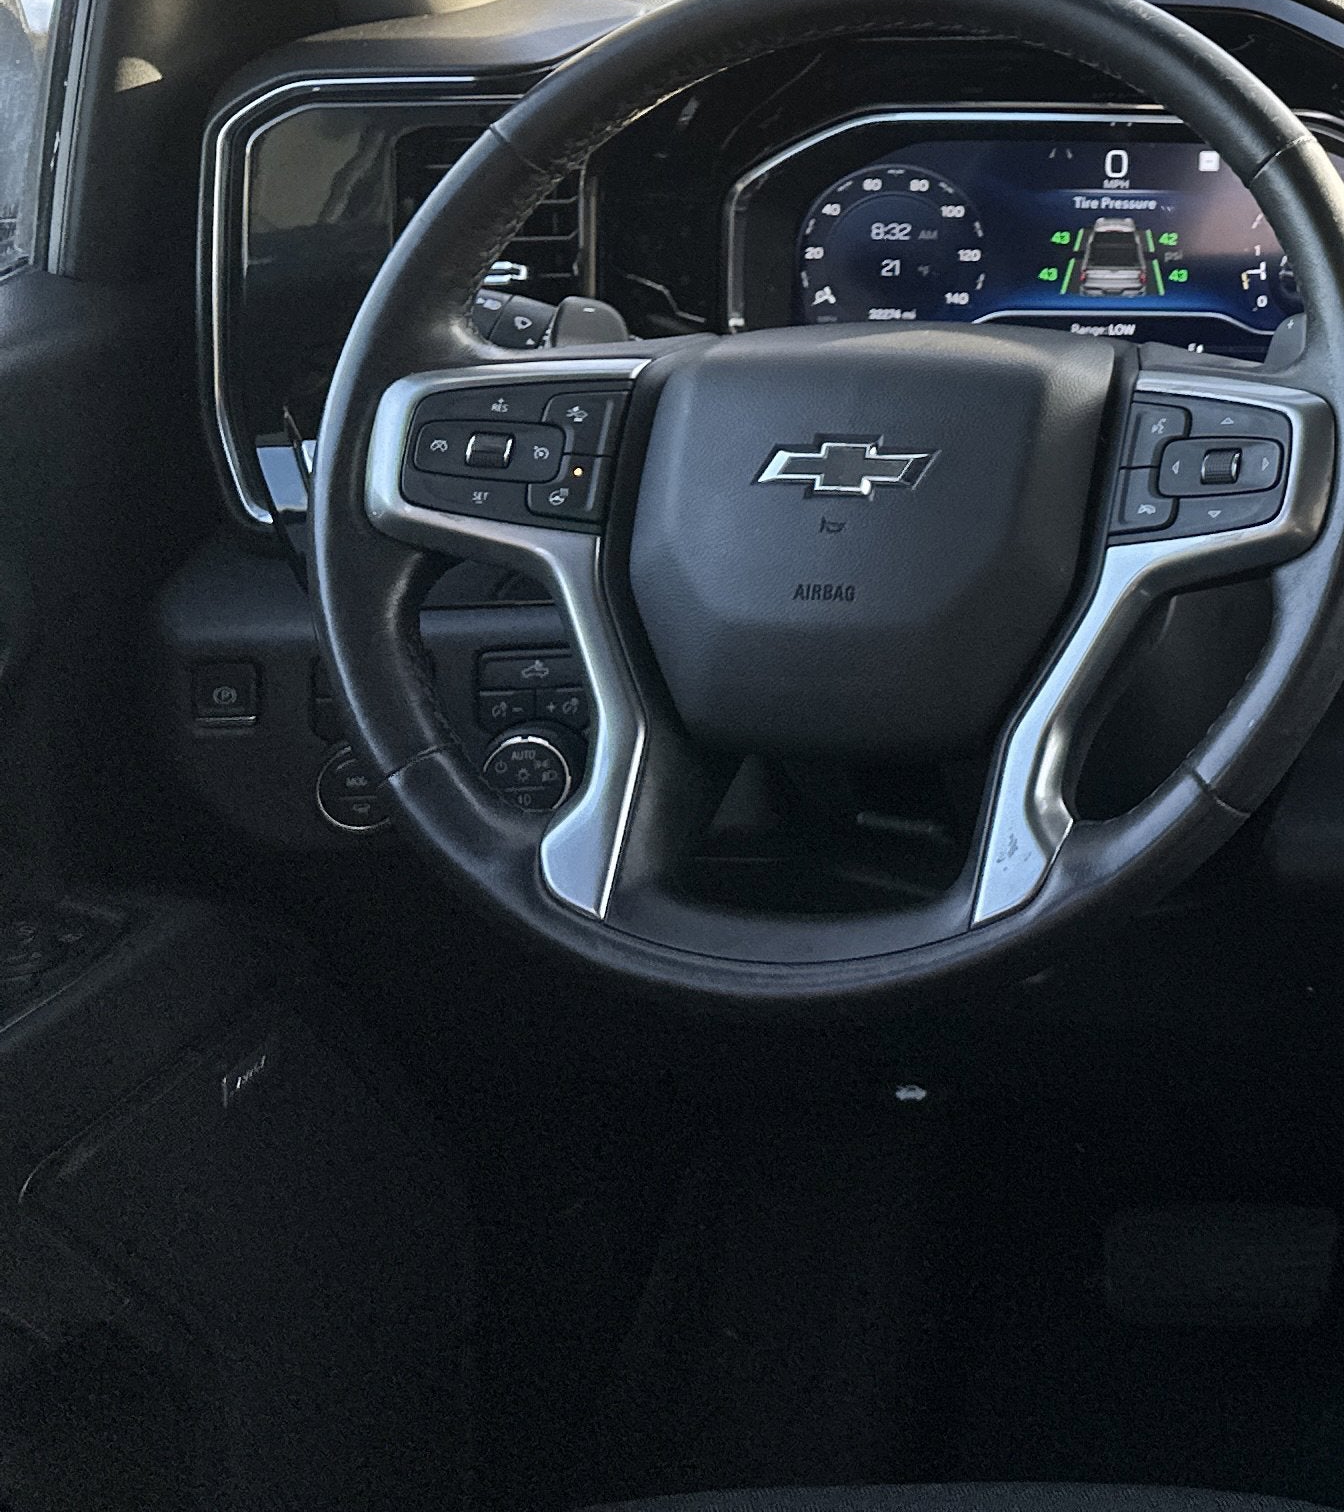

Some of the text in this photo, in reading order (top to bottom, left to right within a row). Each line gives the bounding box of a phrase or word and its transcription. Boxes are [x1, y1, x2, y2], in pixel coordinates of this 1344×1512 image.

[1104, 149, 1129, 178] 0
[1103, 179, 1130, 189] MPH
[821, 203, 841, 216] 40
[1072, 196, 1157, 211] Tire Pressure
[940, 205, 966, 218] 100
[870, 222, 912, 240] 8:32
[1158, 232, 1179, 246] 42
[804, 246, 825, 260] 20
[957, 249, 982, 262] 120
[881, 259, 900, 276] 21
[491, 402, 509, 414] RES
[472, 491, 489, 502] SET
[791, 583, 856, 602] AIRBAG
[511, 749, 536, 761] AUTO
